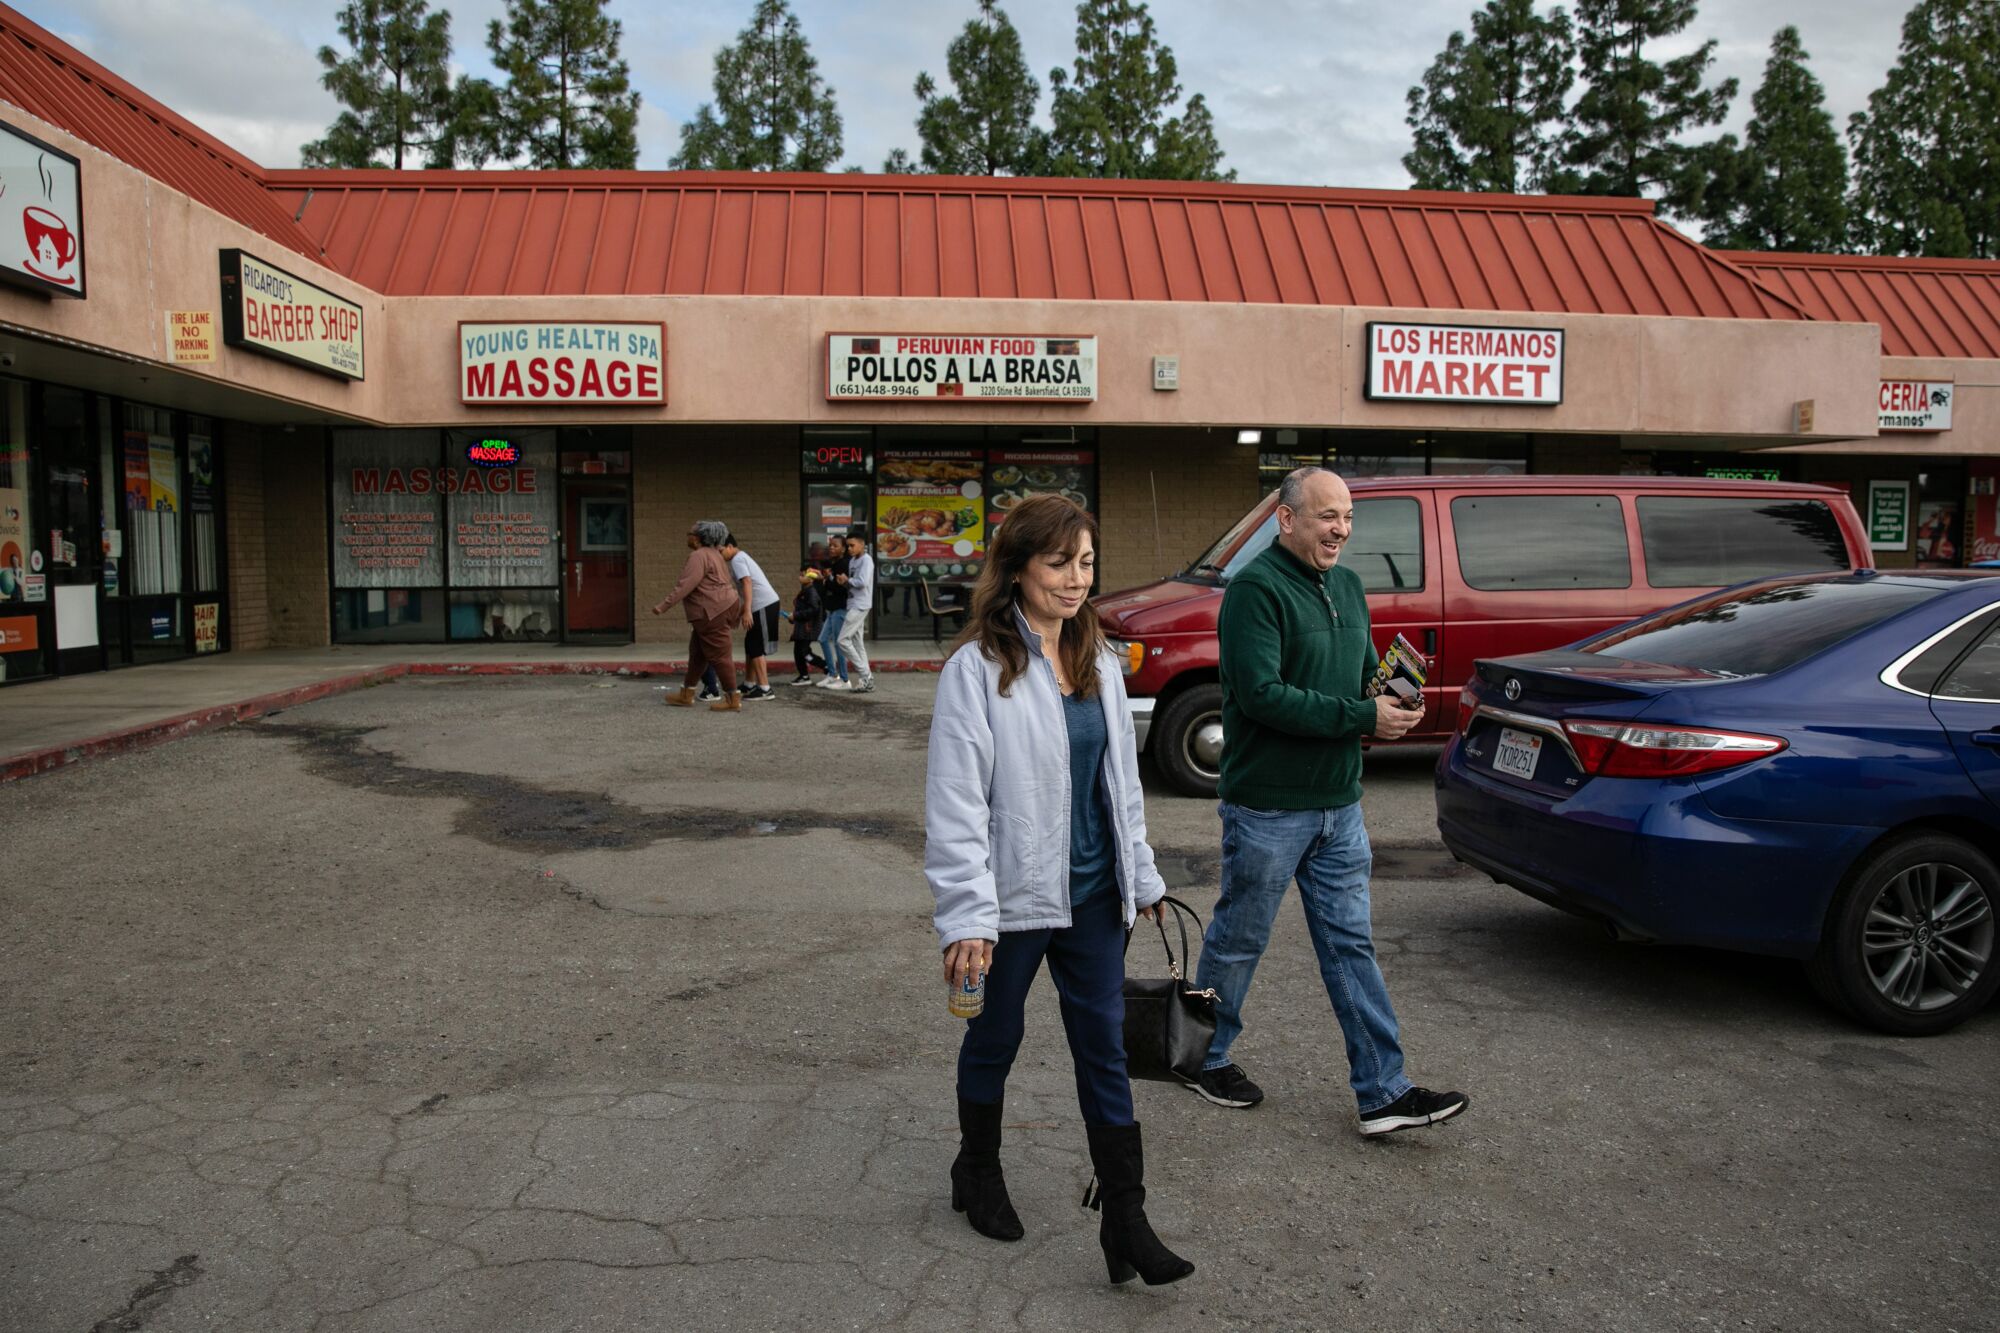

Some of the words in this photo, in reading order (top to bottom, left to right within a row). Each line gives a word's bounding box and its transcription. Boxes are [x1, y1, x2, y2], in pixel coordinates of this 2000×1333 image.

[244, 264, 294, 304] RICARDO'S
[171, 313, 188, 325] FIRE
[190, 313, 210, 325] LANE
[246, 297, 315, 342] BARBER
[320, 305, 360, 343] SHOP
[182, 326, 200, 337] NO
[175, 339, 209, 350] PARKING
[466, 328, 529, 359] YOUNG
[538, 328, 620, 352] HEALTH
[628, 333, 659, 361] SPA
[897, 338, 984, 355] PERUVIAN
[990, 339, 1036, 356] FOOD
[1377, 328, 1420, 354] LOS
[1429, 330, 1557, 359] HERMANOS
[467, 356, 659, 398] MASSAGE
[847, 356, 937, 383] POLLOS
[944, 357, 960, 383] A
[969, 357, 998, 383] LA
[1005, 358, 1082, 384] BRASA
[1382, 359, 1550, 398] MARKET
[482, 440, 508, 449] OPEN
[470, 448, 516, 461] MASSAGE
[817, 447, 863, 464] OPEN
[352, 467, 538, 495] MASSAGE
[473, 512, 504, 523] OPEN
[508, 512, 533, 523] FOR
[504, 523, 549, 534] Women
[194, 606, 216, 621] HAIR
[195, 626, 217, 641] AILS
[1498, 744, 1534, 773] 7KDR251
